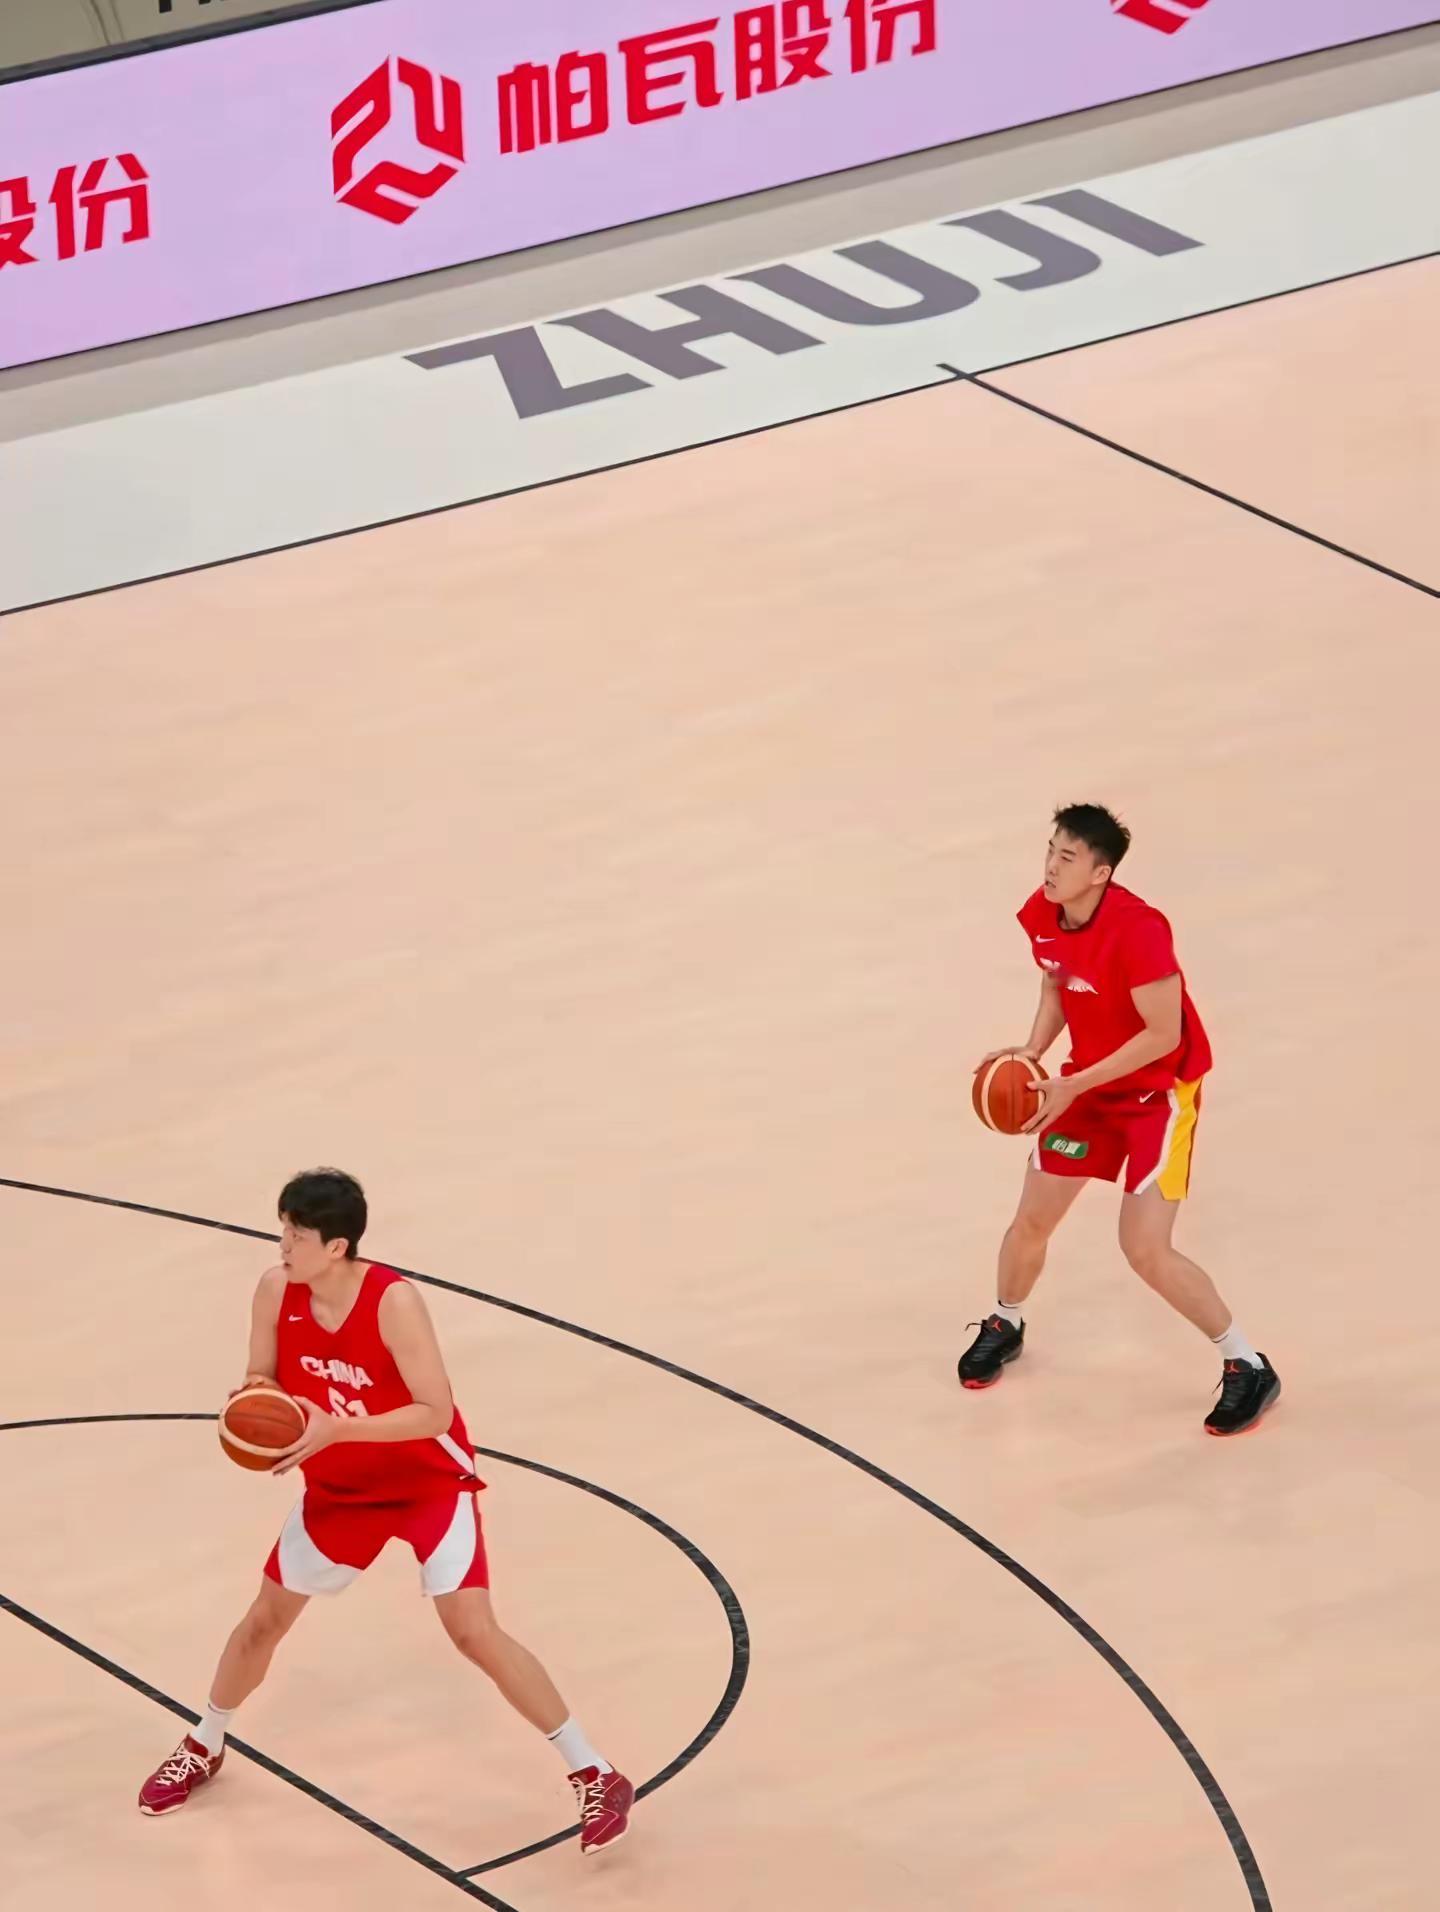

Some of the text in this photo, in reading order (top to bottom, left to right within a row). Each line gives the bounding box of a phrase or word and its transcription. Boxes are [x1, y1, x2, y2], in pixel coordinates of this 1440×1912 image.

[497, 0, 936, 154] 帕瓦股份
[404, 188, 1206, 419] ZHUJI
[300, 1355, 375, 1391] CHINA
